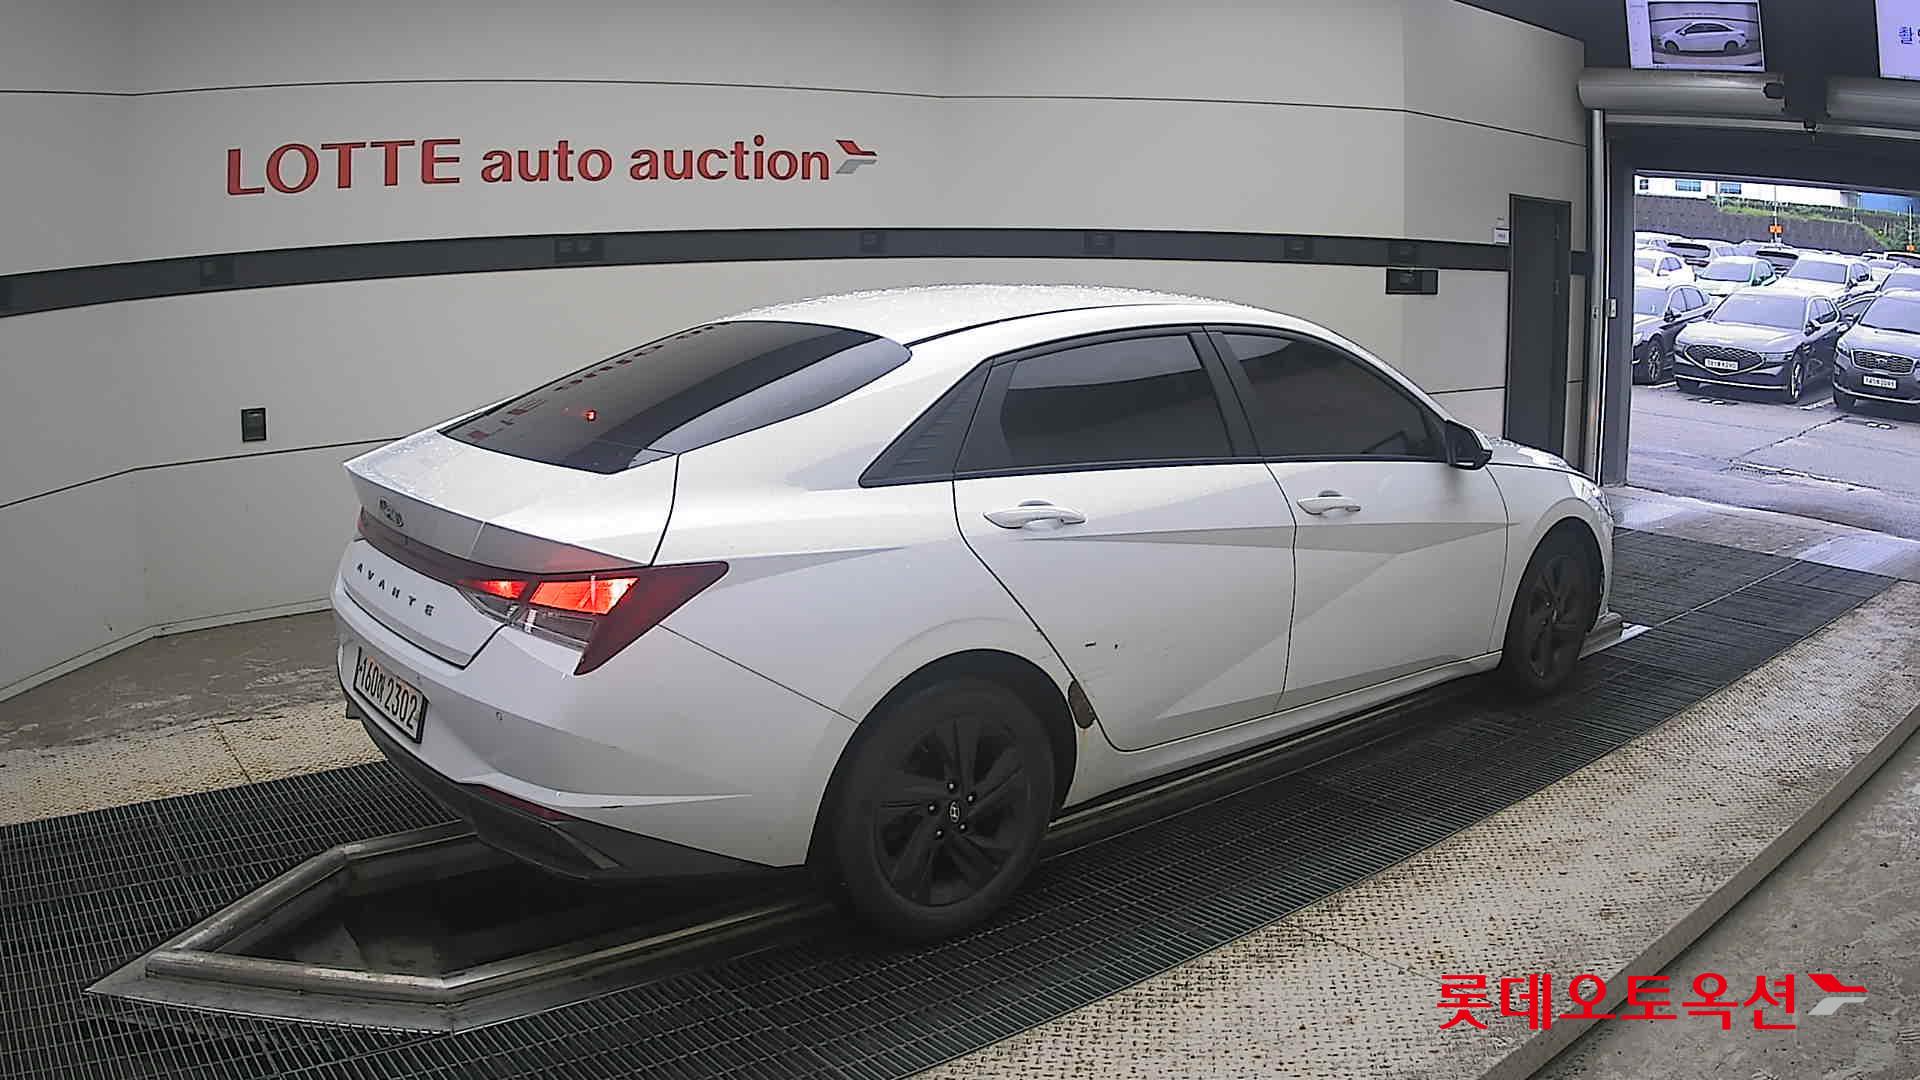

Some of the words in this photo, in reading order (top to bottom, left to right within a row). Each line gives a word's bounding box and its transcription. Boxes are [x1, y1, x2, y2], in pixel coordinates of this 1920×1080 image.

[227, 138, 461, 195] LOTTE
[480, 140, 612, 181] auto
[629, 134, 830, 181] auction
[356, 563, 434, 616] AVANTE
